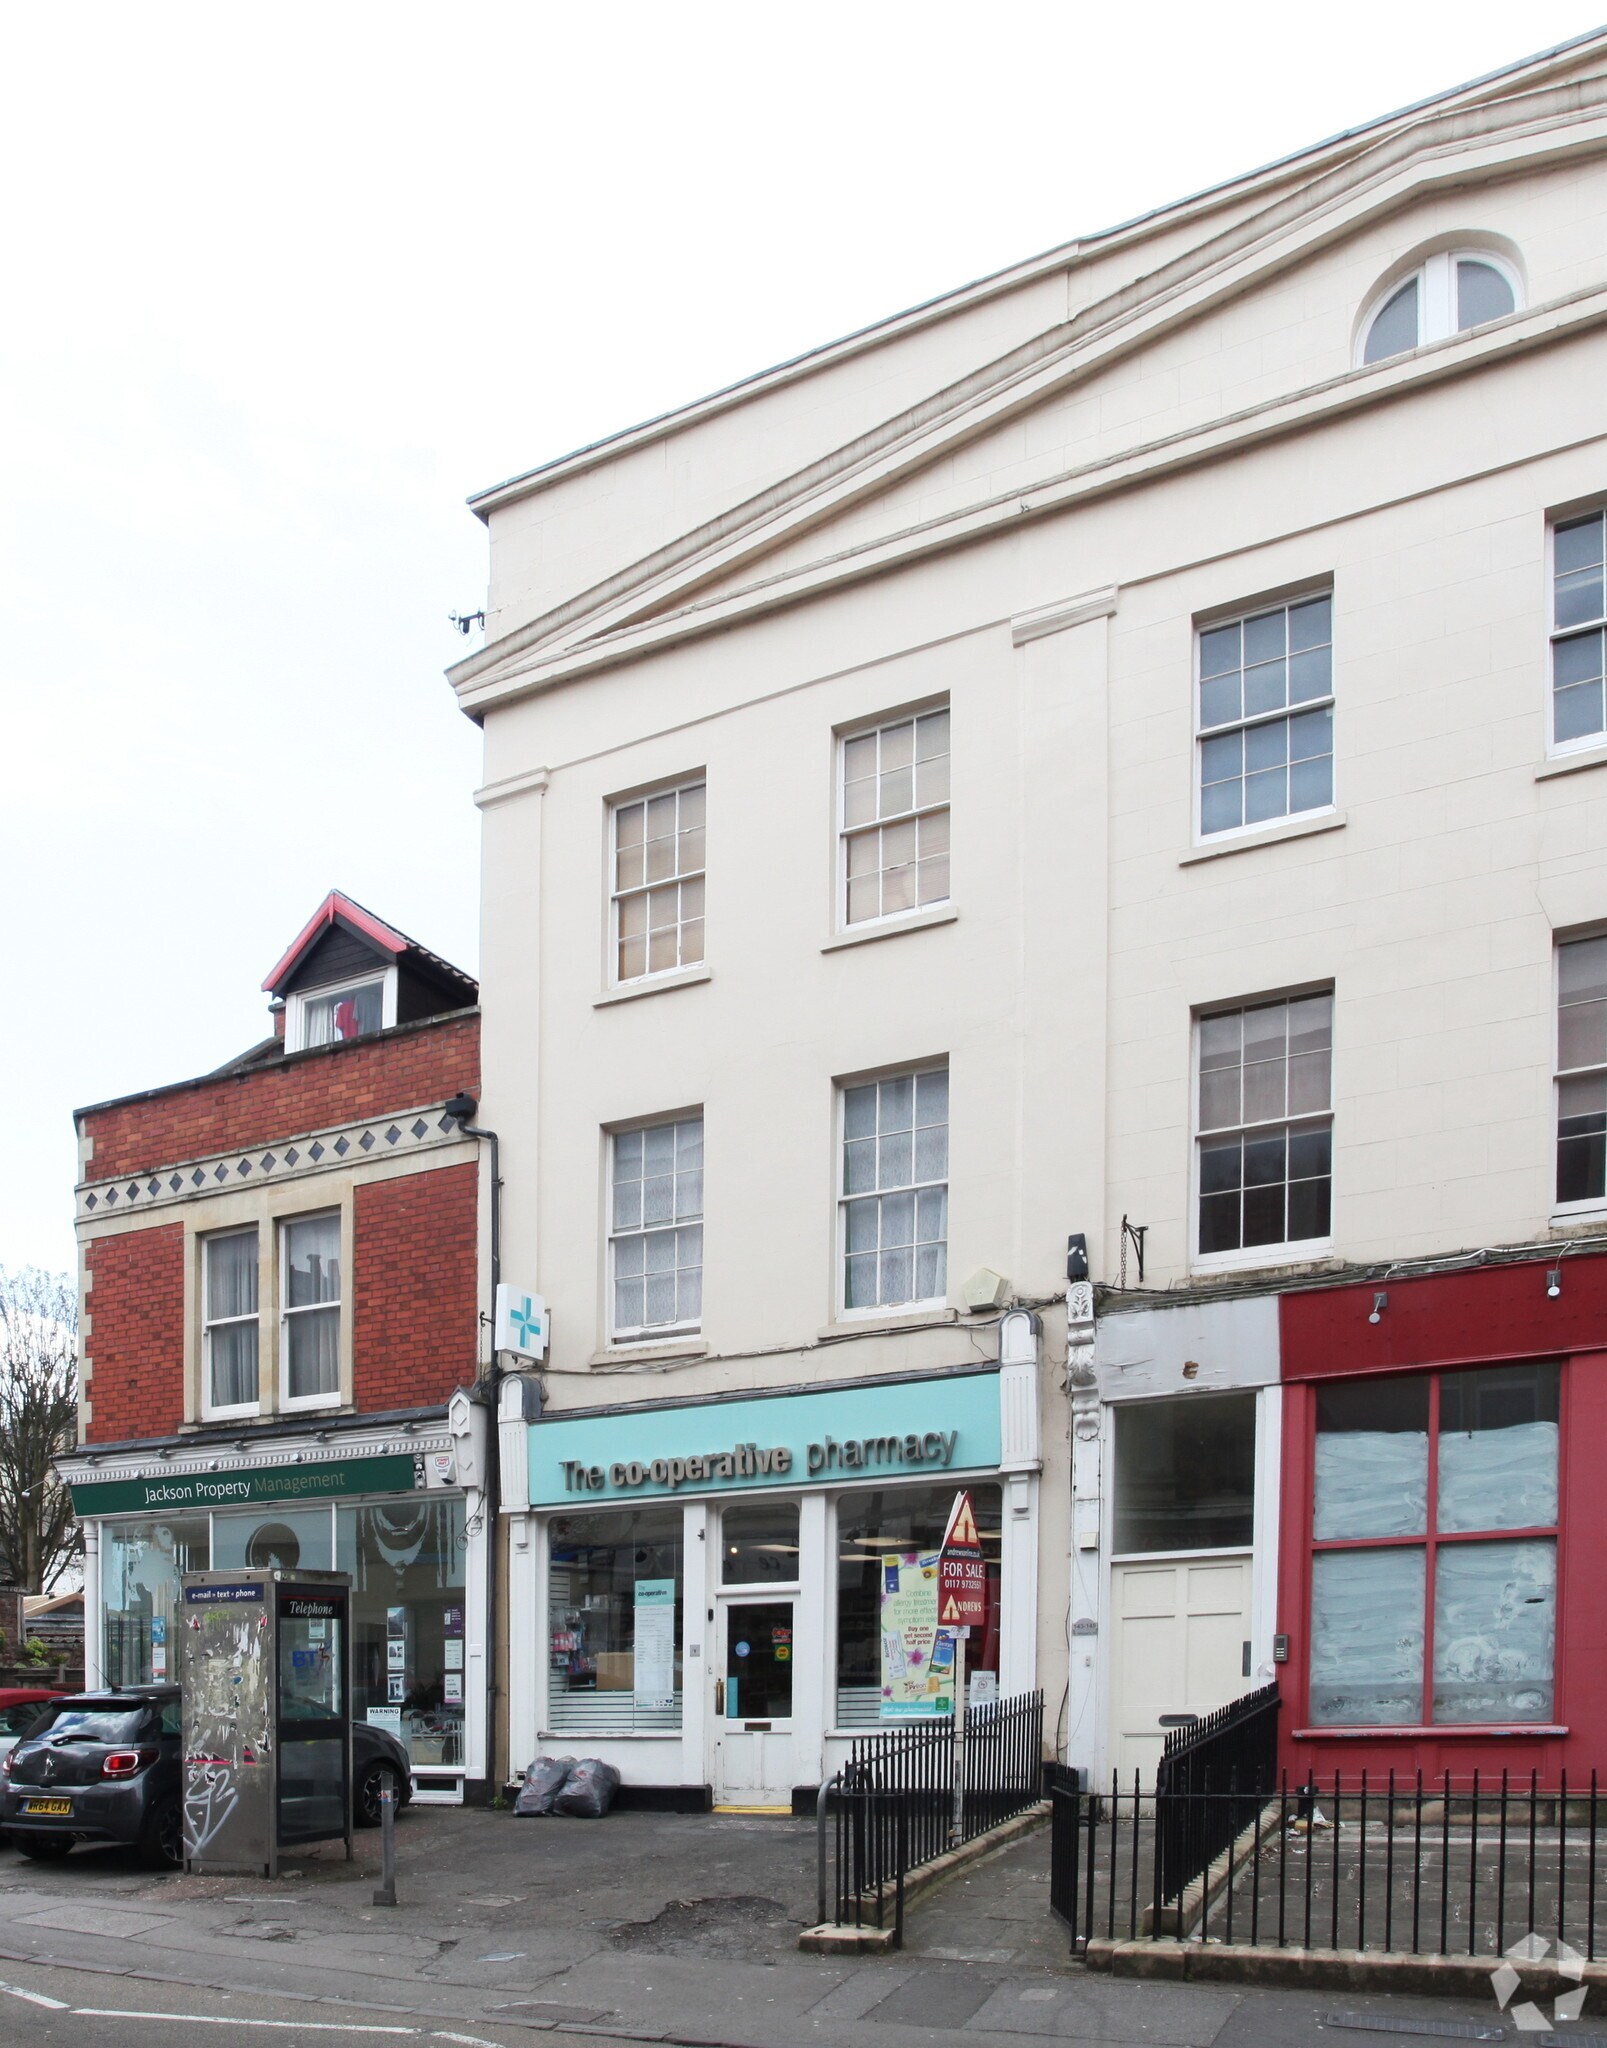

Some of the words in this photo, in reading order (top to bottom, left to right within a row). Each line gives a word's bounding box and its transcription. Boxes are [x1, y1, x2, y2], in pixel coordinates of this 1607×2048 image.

[558, 1460, 604, 1491] The
[608, 1443, 792, 1489] co-operative
[806, 1430, 959, 1477] pharmacy
[144, 1486, 192, 1504] Jackson
[196, 1480, 251, 1500] Property
[254, 1471, 346, 1494] Management
[943, 1562, 963, 1577] FOR
[965, 1564, 983, 1578] SALE
[944, 1579, 959, 1588] 0117
[191, 1591, 211, 1599] e-mail
[235, 1589, 256, 1599] phone
[289, 1601, 333, 1616] Telephone
[292, 1650, 318, 1667] BT
[27, 1799, 49, 1811] WR64
[51, 1800, 70, 1812] GAX
